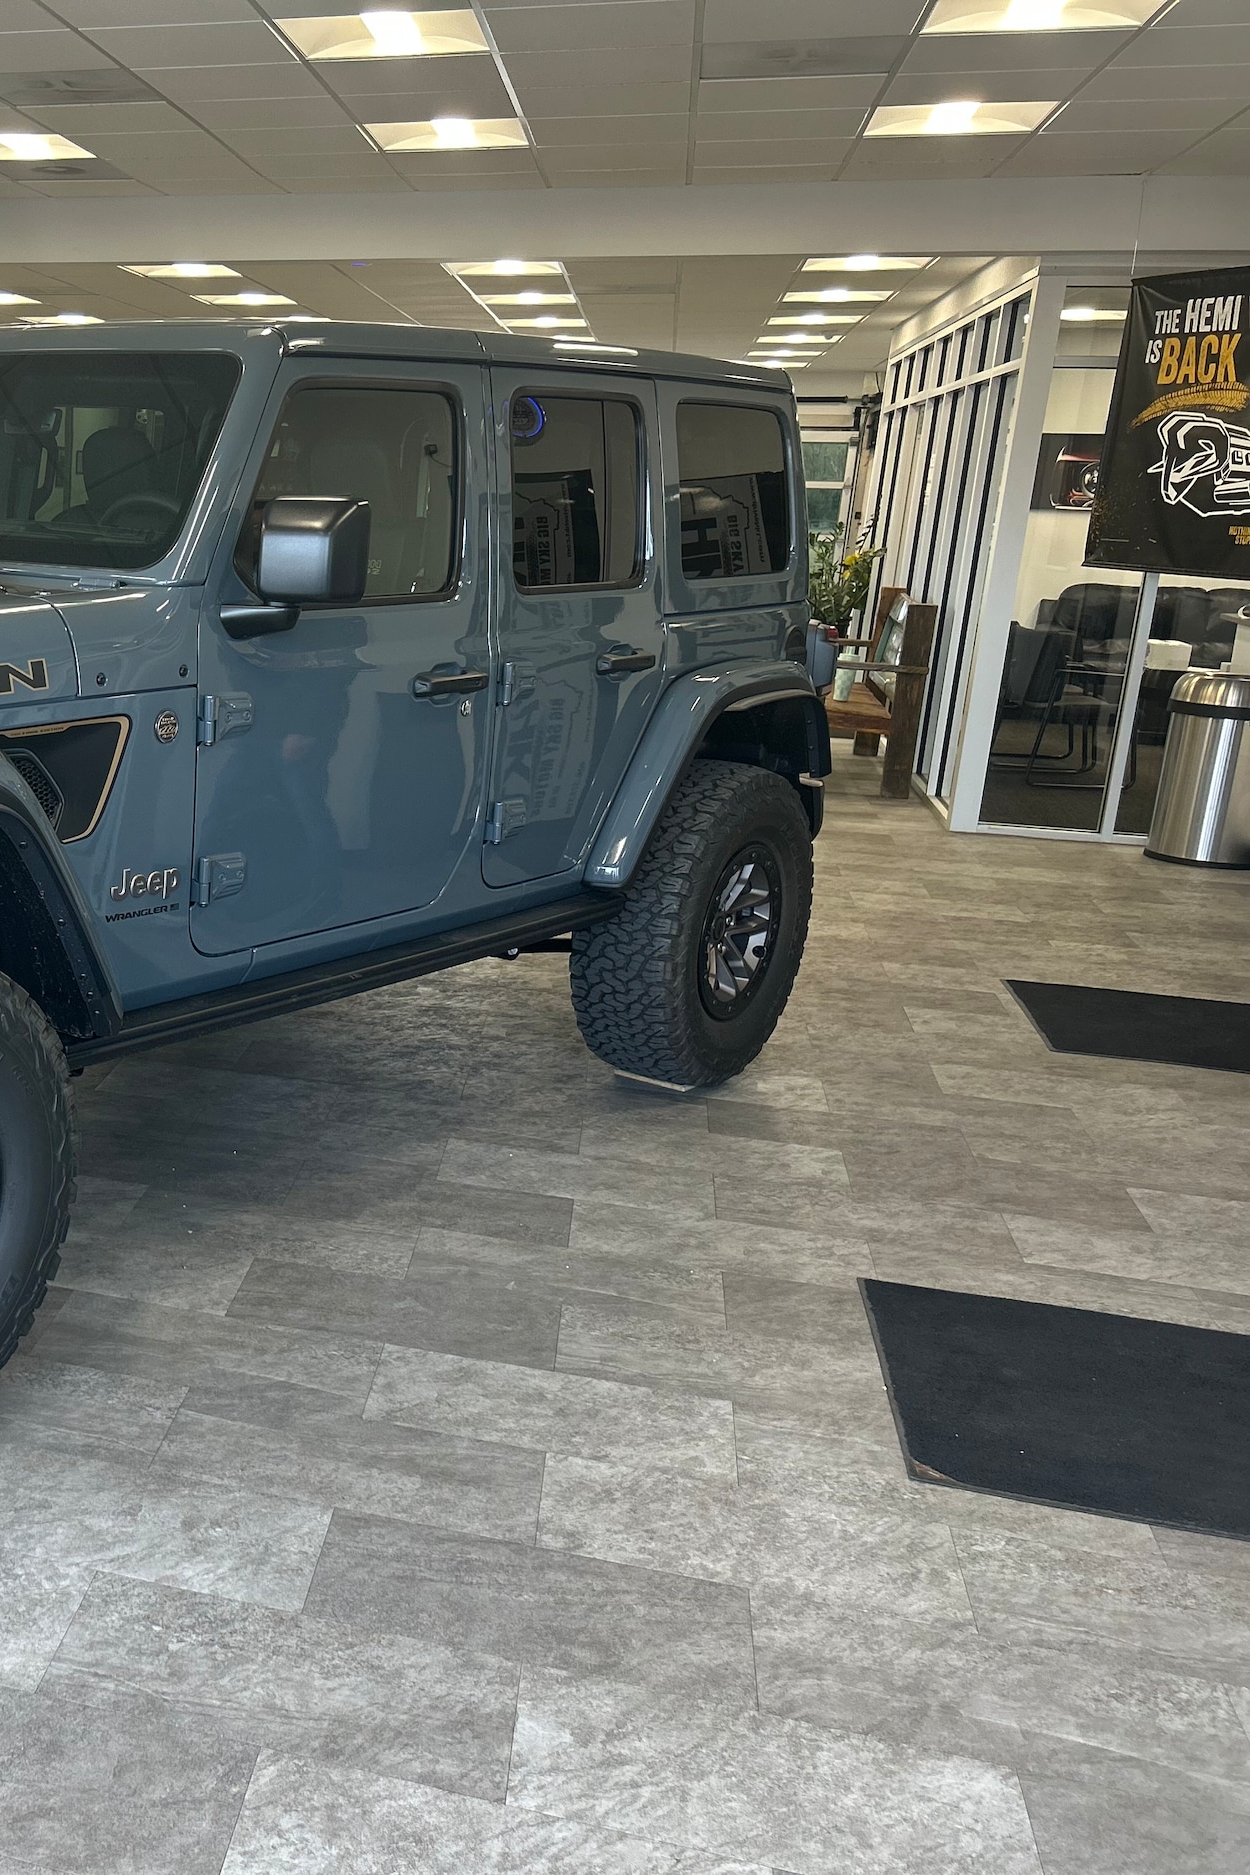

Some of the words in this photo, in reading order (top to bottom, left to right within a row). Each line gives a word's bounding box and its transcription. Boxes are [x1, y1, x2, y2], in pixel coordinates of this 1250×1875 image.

[1155, 309, 1181, 334] THE
[1184, 295, 1242, 333] HEMI
[1145, 340, 1163, 363] IS
[1157, 333, 1242, 385] BACK
[110, 868, 181, 901] Jeep
[105, 905, 168, 923] WRANGLER
